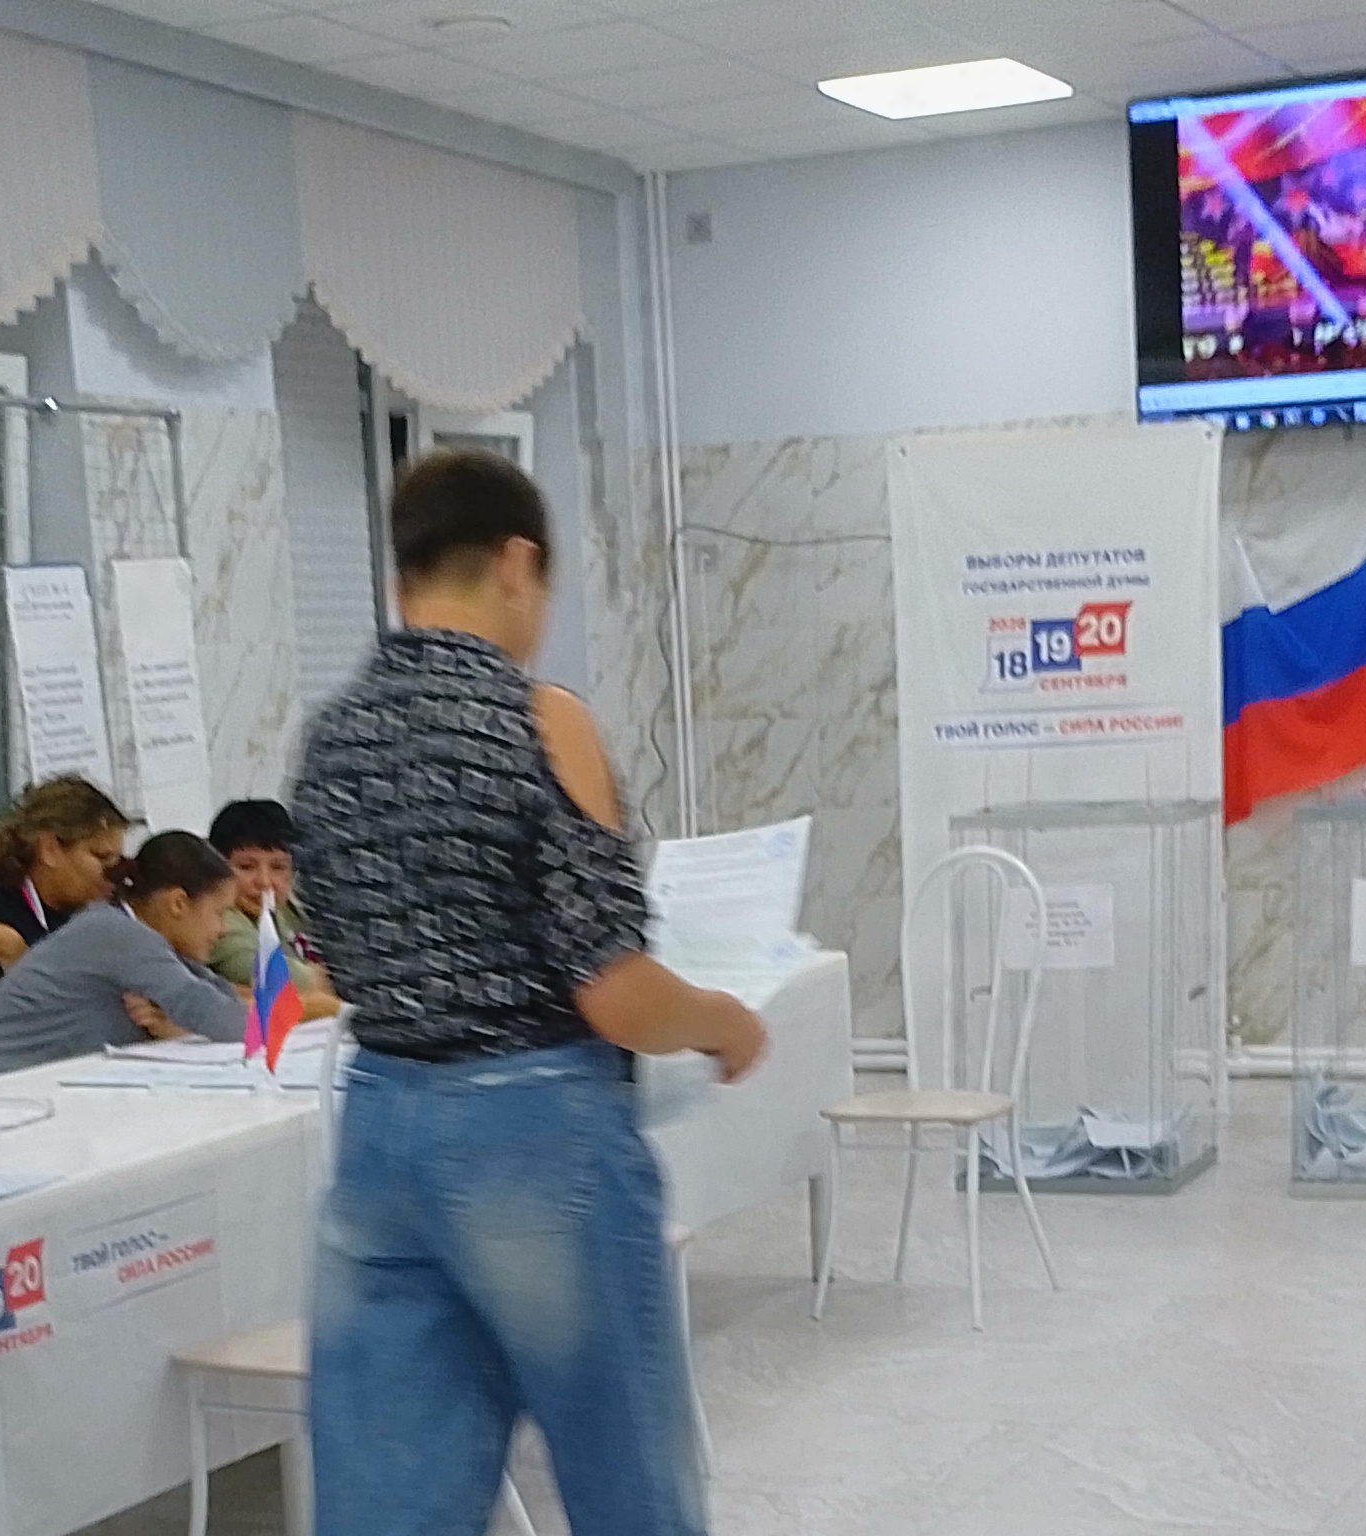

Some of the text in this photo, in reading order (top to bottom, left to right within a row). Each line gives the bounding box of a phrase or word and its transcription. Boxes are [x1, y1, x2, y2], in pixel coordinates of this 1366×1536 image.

[966, 549, 1146, 570] ВЫБОРЫ ДЕПУТАТОВ
[994, 612, 1123, 680] 18 19 20
[7, 1255, 41, 1298] 20
